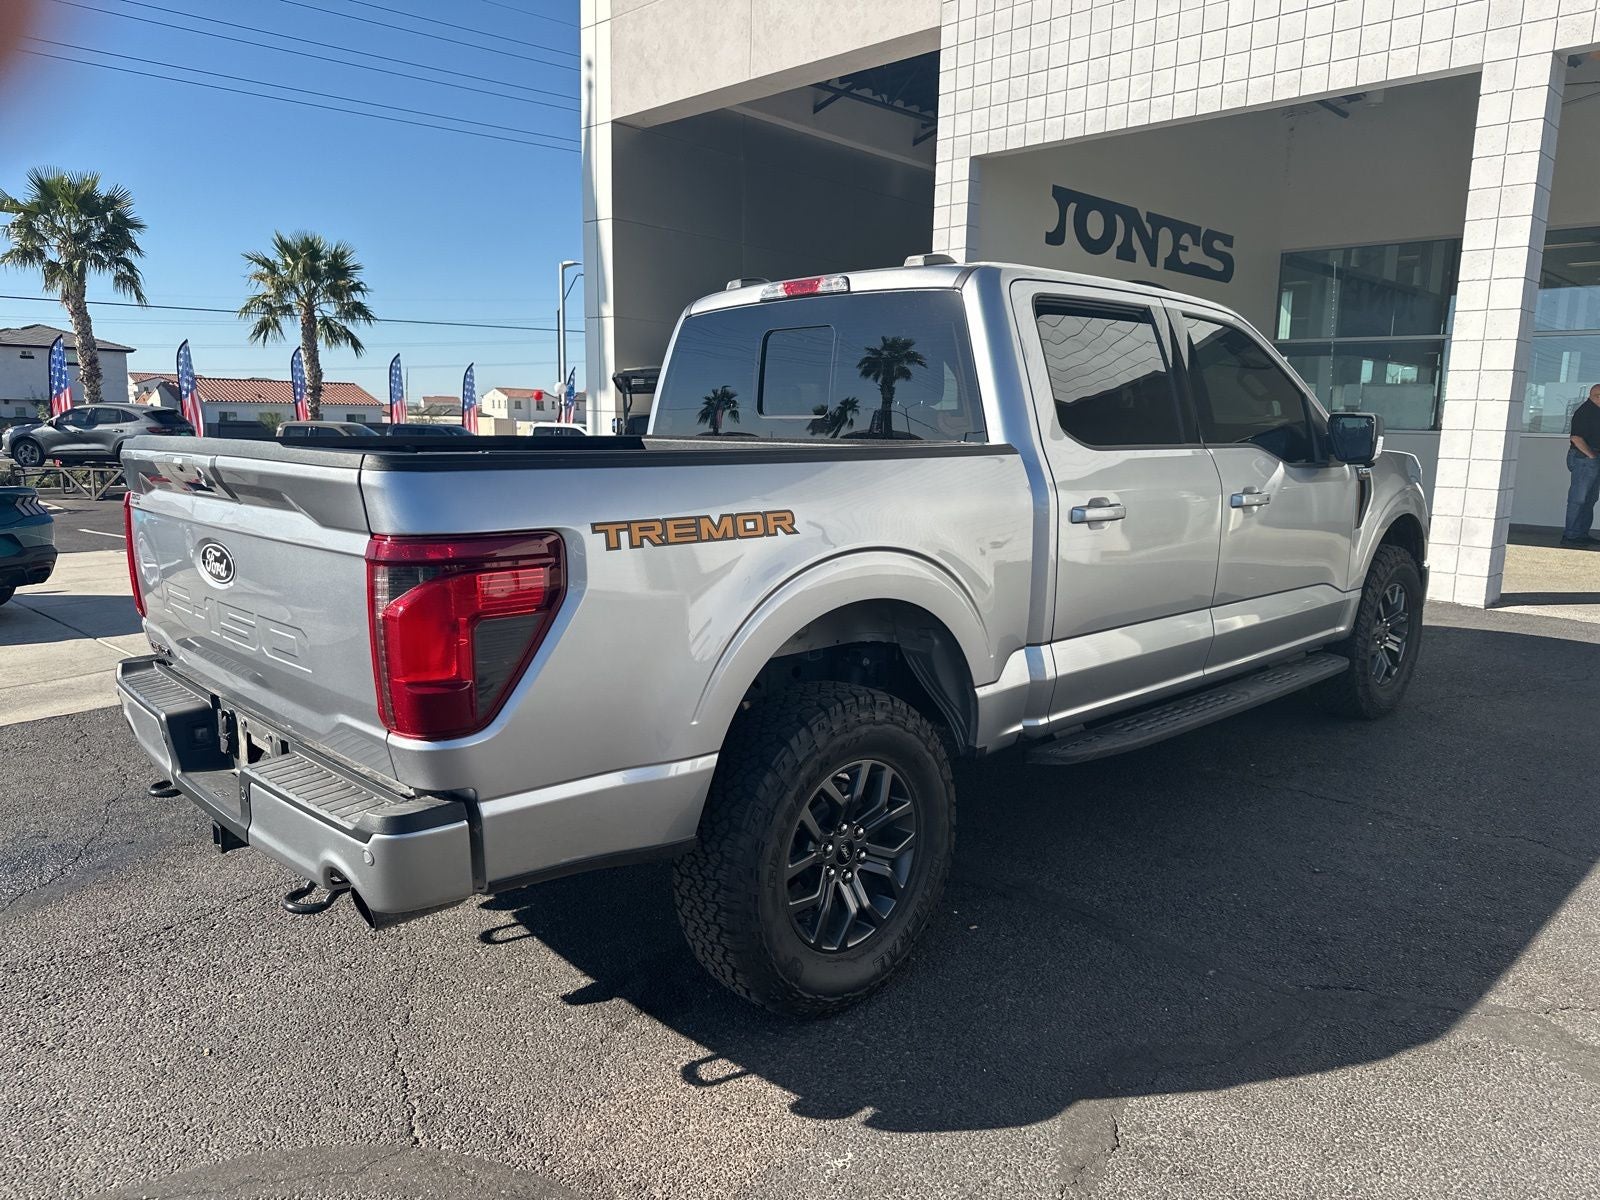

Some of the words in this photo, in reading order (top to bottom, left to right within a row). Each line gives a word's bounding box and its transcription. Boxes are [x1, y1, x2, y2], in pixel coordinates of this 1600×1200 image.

[1045, 184, 1234, 283] JONES
[206, 547, 227, 577] Ford
[591, 509, 800, 551] TREMOR
[161, 579, 312, 673] F-150
